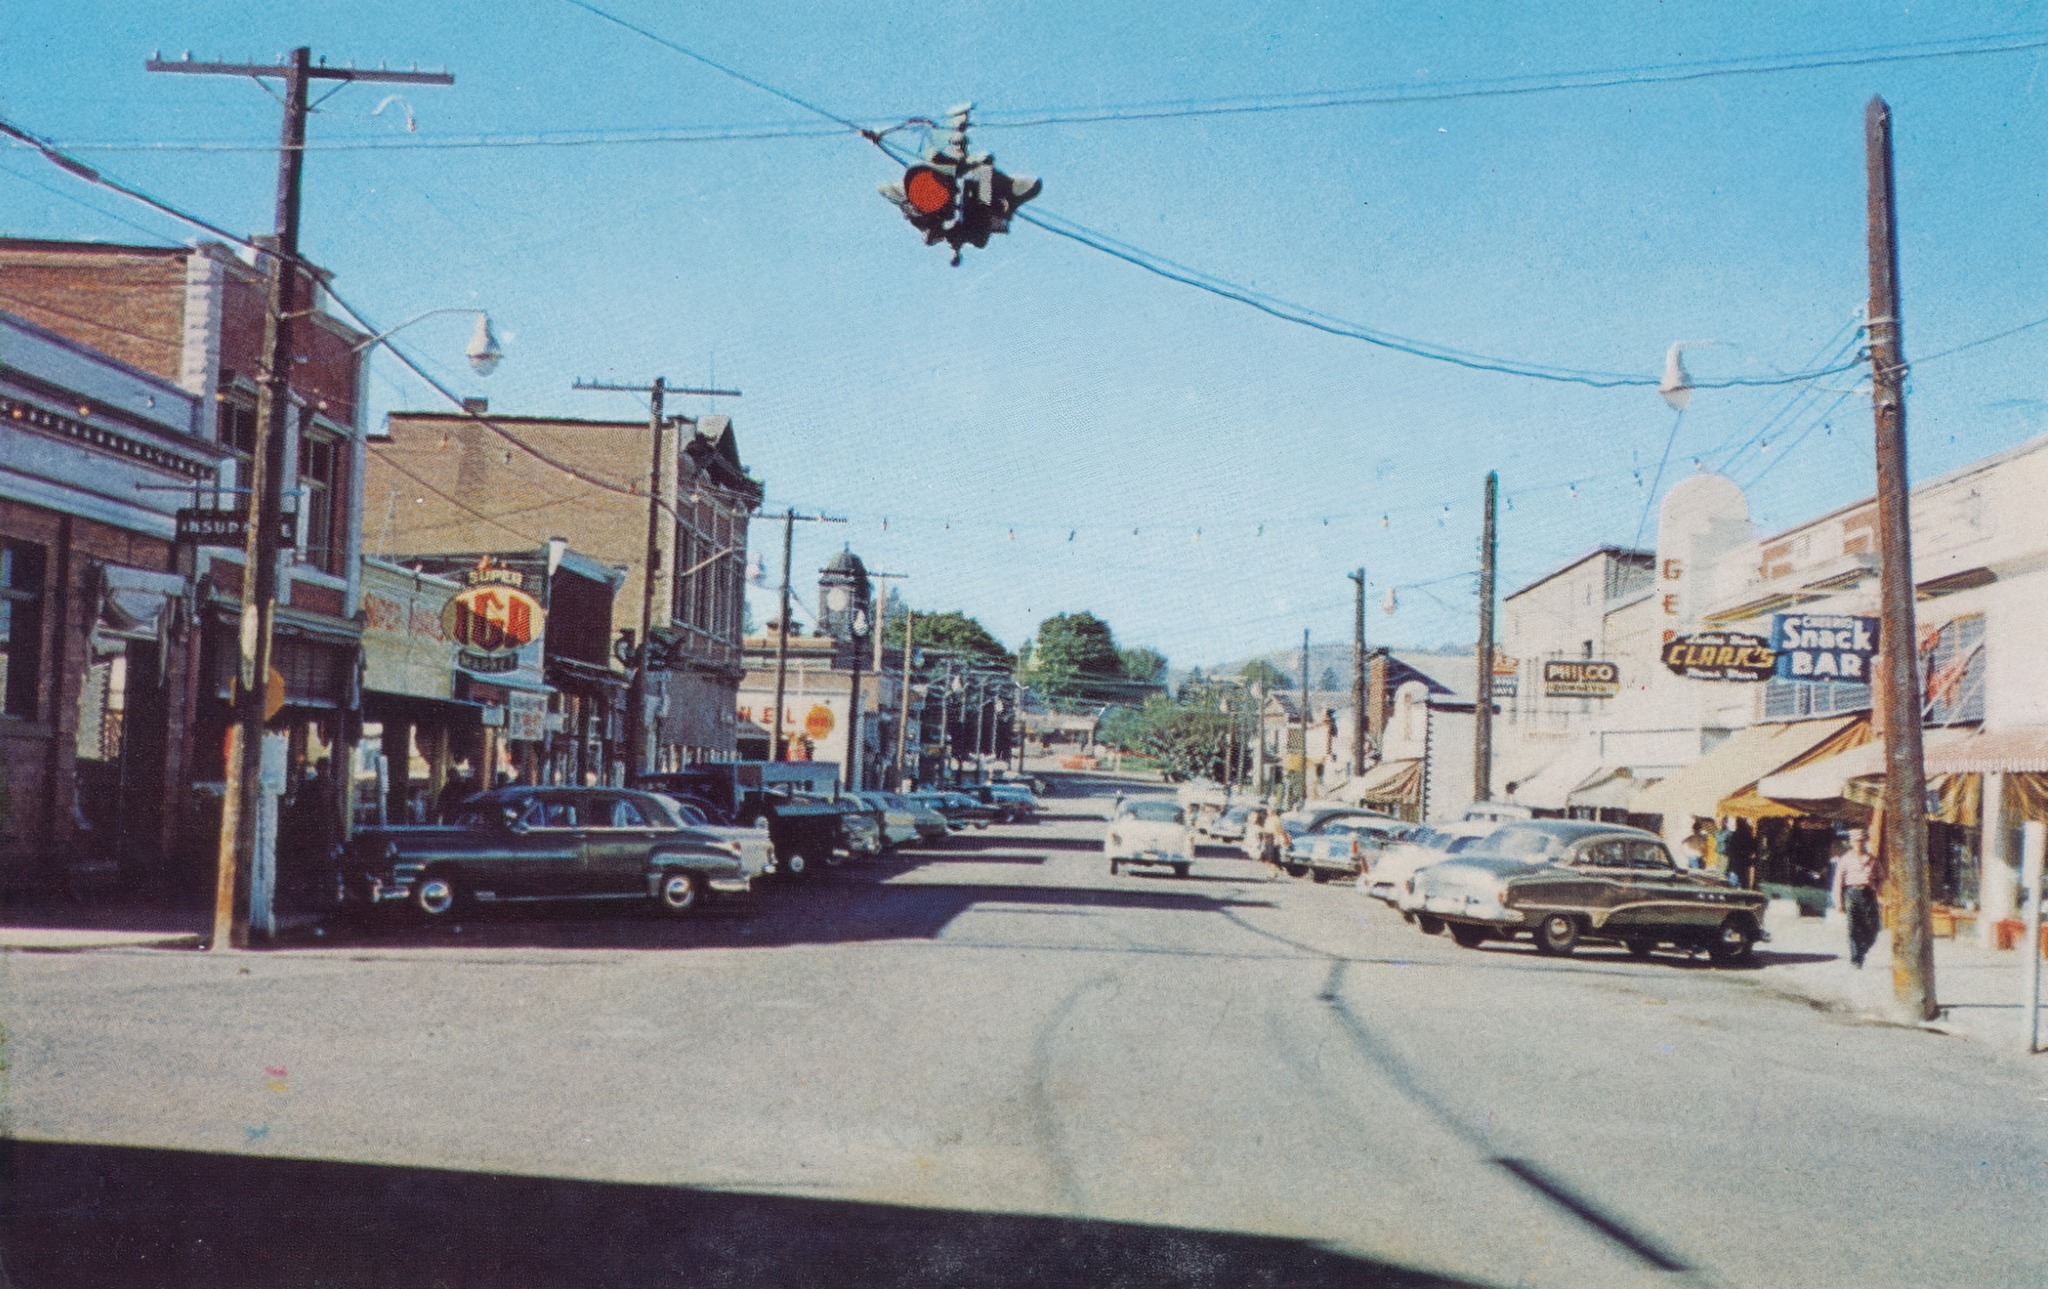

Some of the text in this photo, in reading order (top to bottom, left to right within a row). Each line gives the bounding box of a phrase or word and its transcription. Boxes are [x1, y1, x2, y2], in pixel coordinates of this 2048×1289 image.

[180, 521, 291, 538] INSURE
[469, 568, 523, 587] SUPER
[453, 590, 532, 653] IGA
[1782, 617, 1872, 651] Snack
[1669, 644, 1776, 668] CLARK'S
[1791, 651, 1862, 677] BAR
[1548, 664, 1614, 681] PHILCO
